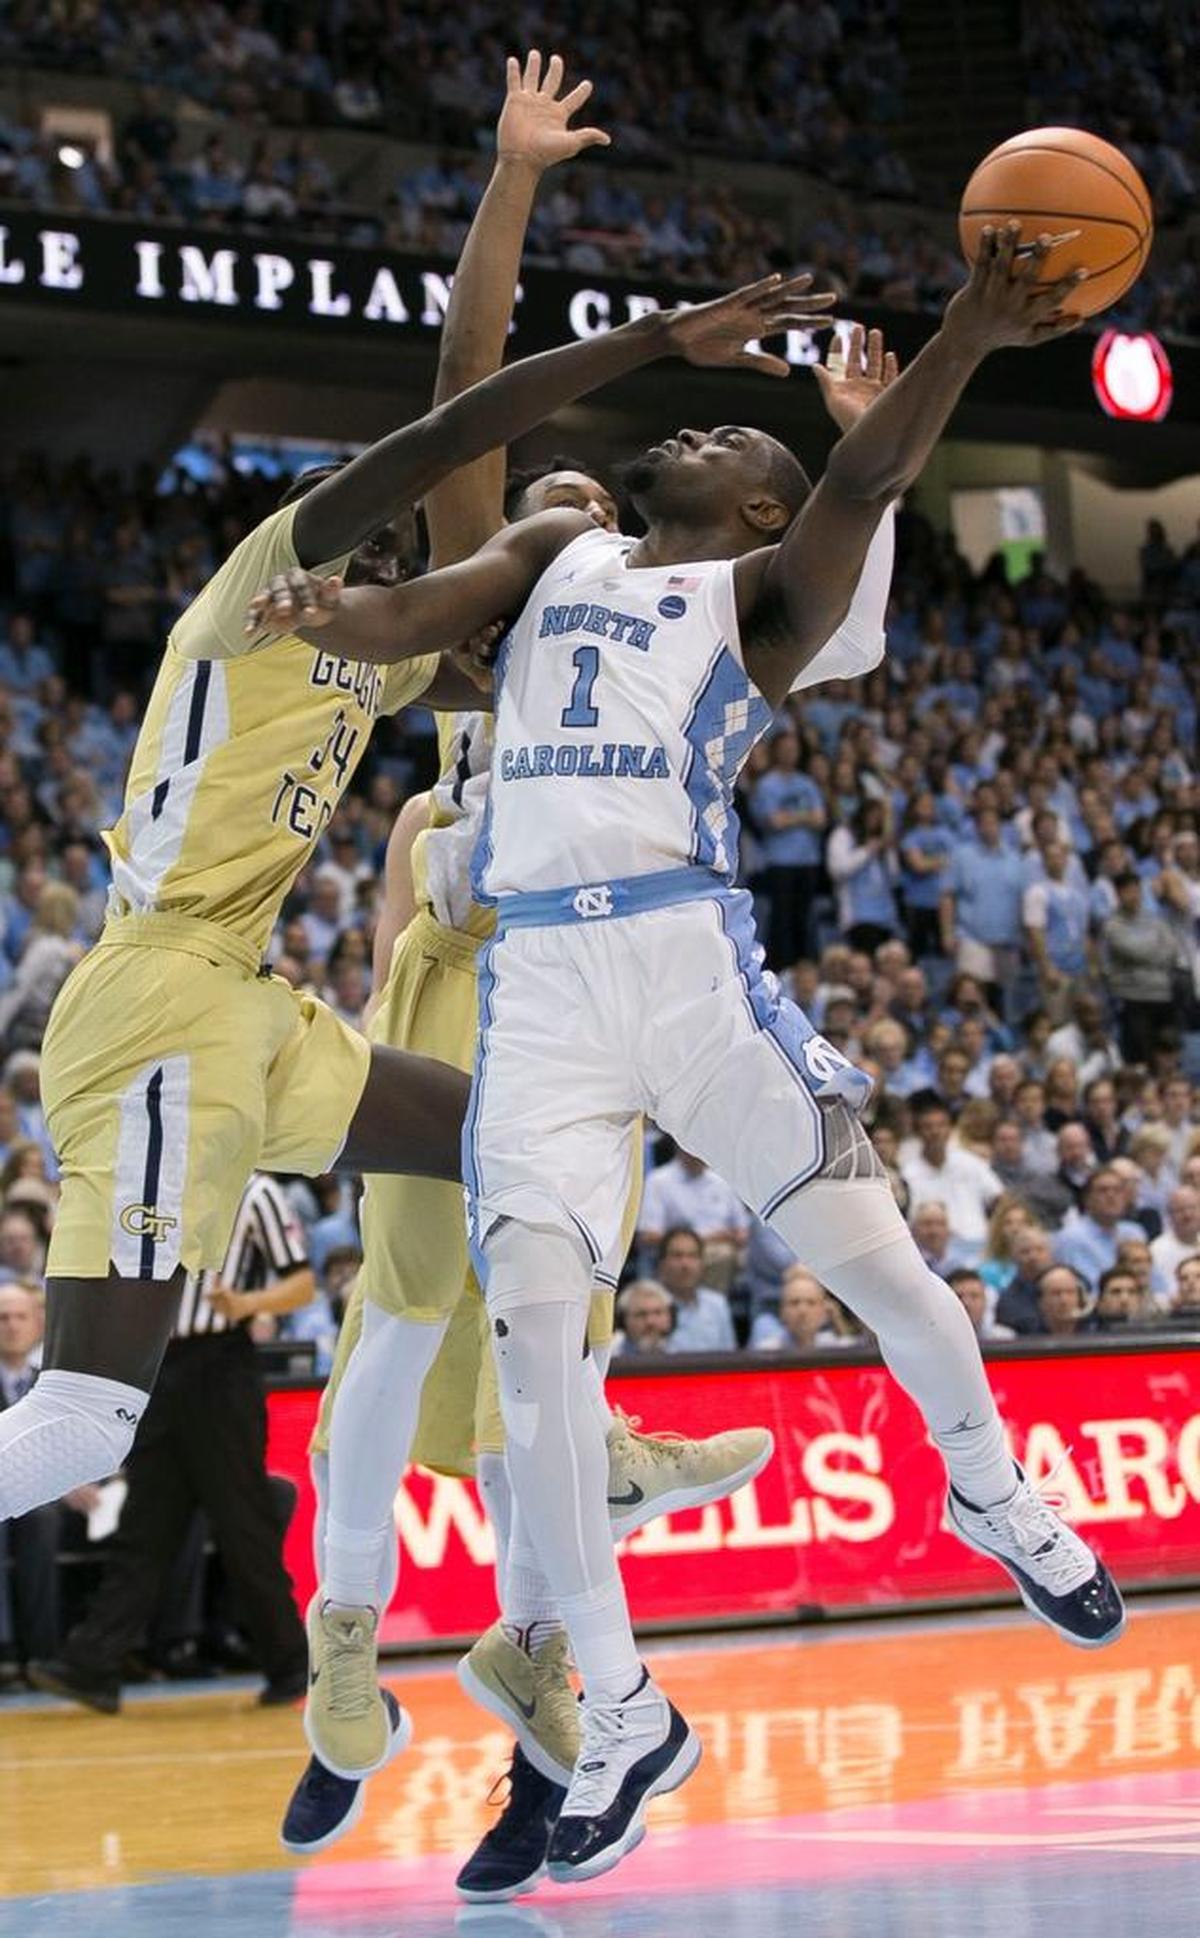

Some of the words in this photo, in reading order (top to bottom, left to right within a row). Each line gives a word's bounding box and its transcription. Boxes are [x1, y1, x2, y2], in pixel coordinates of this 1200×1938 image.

[134, 241, 524, 334] IMPLAN
[539, 603, 656, 652] NORTH
[560, 646, 600, 728] 1
[500, 744, 671, 782] CAROLINA
[119, 1203, 177, 1242] GT
